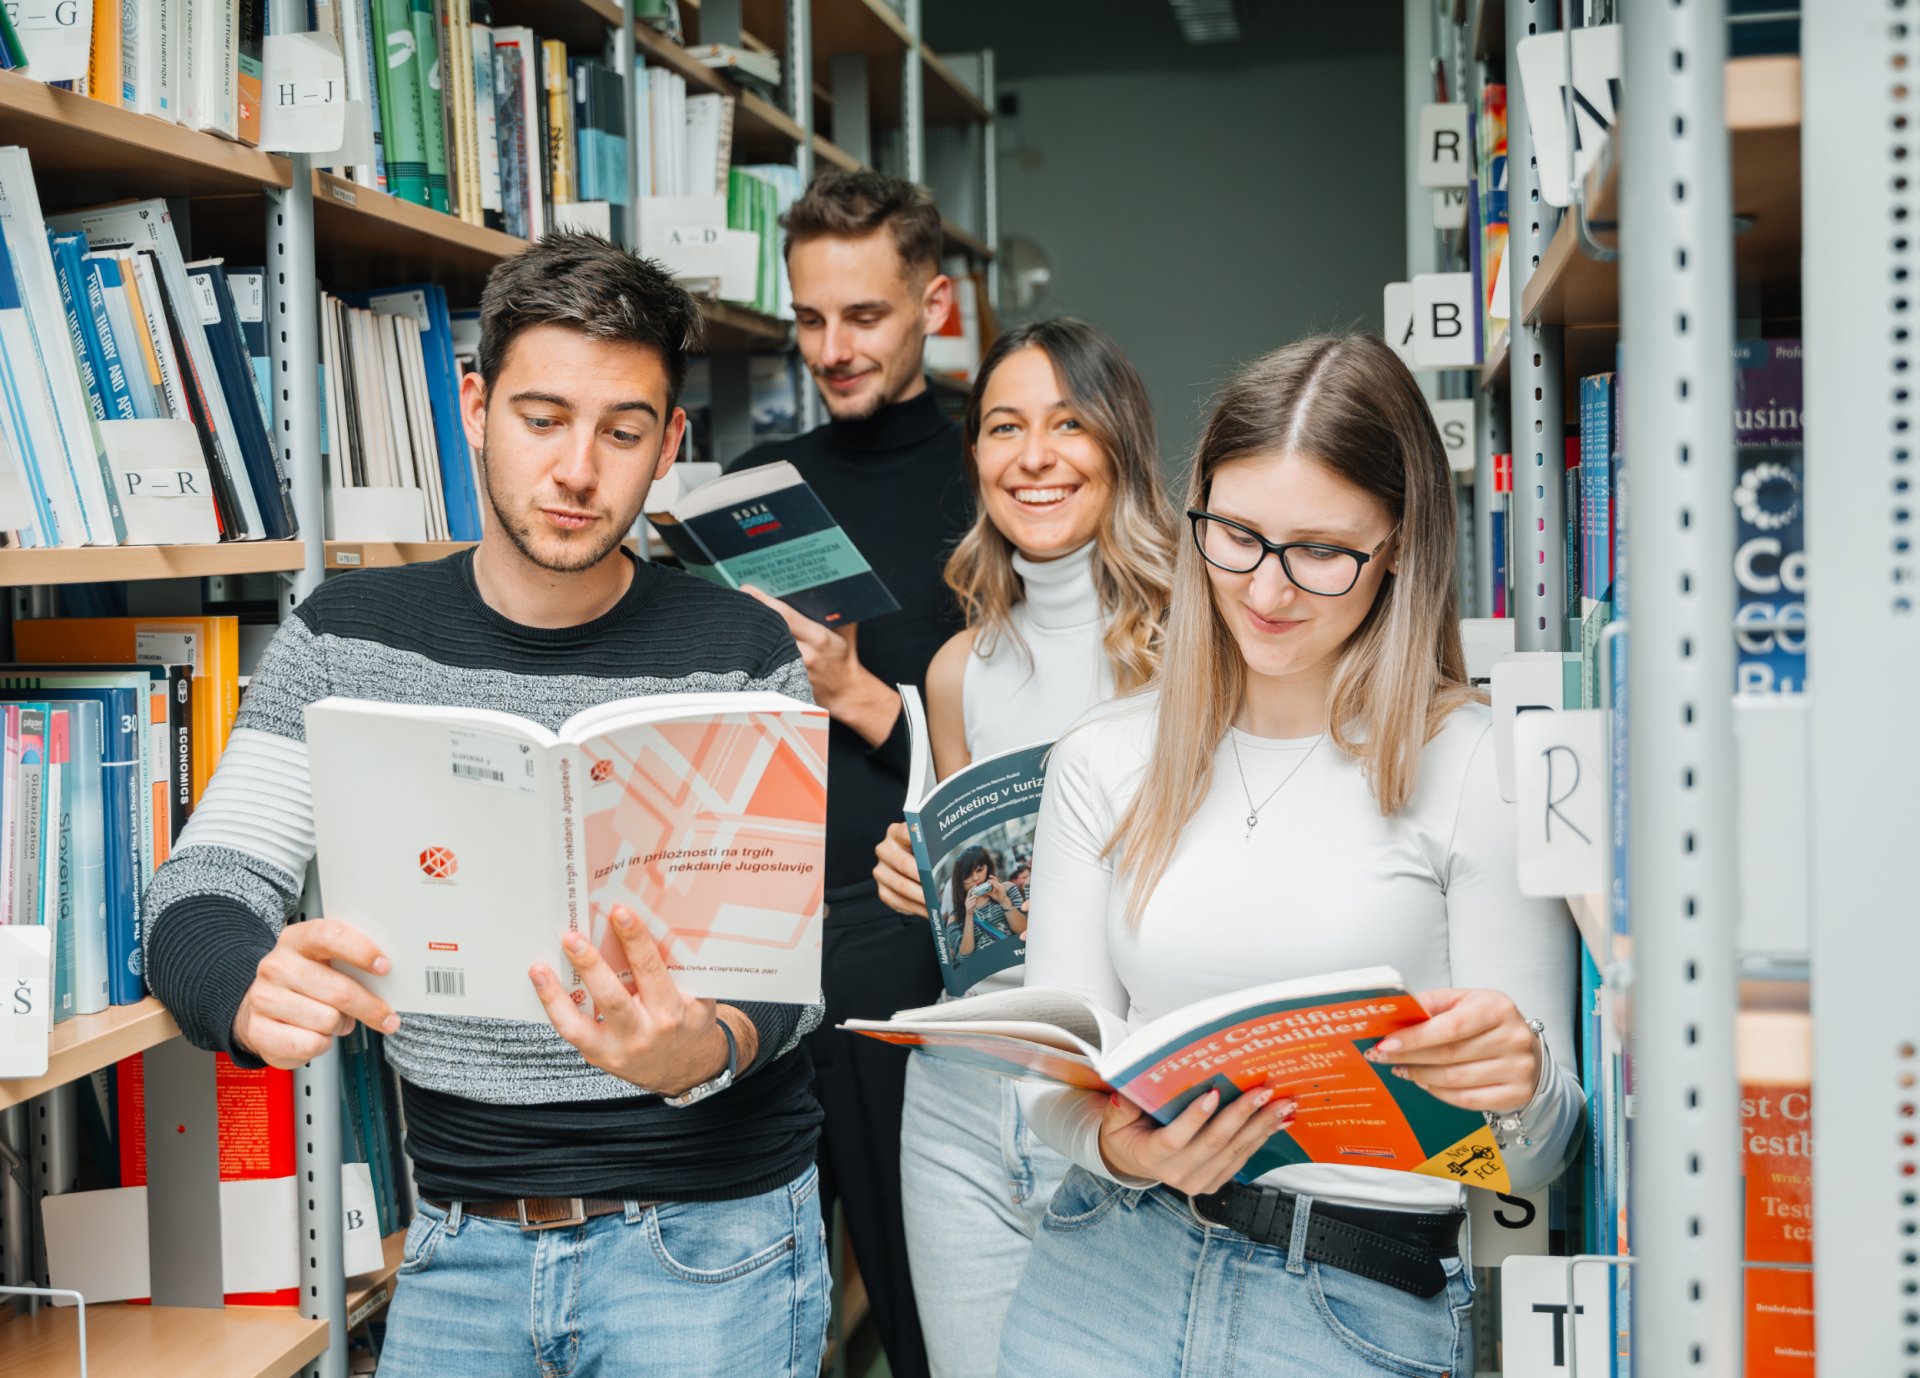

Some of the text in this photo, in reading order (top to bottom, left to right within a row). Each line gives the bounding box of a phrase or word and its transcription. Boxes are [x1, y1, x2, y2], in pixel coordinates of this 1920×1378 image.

[55, 0, 78, 26] G
[160, 33, 168, 88] TOURISTIQUE
[278, 83, 296, 106] H
[324, 80, 334, 104] J
[1432, 130, 1460, 163] R
[668, 230, 682, 246] A
[703, 228, 717, 244] D
[58, 267, 73, 306] PRICE
[67, 307, 87, 356] THEORY
[81, 361, 96, 391] AND
[86, 271, 103, 312] PRICE
[95, 313, 117, 361] THEORY
[108, 364, 126, 393] AND
[1431, 302, 1462, 338] B
[1442, 419, 1465, 451] S
[124, 472, 142, 495] P
[175, 471, 200, 494] R
[1600, 401, 1608, 536] BUSINESS MATTERS
[121, 713, 138, 734] 30
[179, 727, 189, 805] ECONOMICS
[129, 776, 137, 811] Decade
[560, 758, 574, 815] Jugoslavije
[1540, 745, 1592, 844] R
[30, 773, 39, 860] Globalization
[130, 813, 138, 833] Last
[938, 791, 999, 832] Marketing
[1001, 787, 1010, 797] v
[563, 817, 576, 860] nekdanje
[132, 852, 139, 862] of
[593, 861, 626, 880] Izzivi
[628, 855, 641, 866] in
[643, 847, 718, 865] priložnosti
[742, 847, 774, 859] trgih
[669, 860, 814, 874] nekdanje Jugoslavije
[566, 863, 579, 887] trgih
[132, 863, 140, 921] Significance
[568, 888, 578, 900] na
[938, 935, 950, 965] Marketing
[709, 966, 760, 974] KONFERENCA
[13, 979, 32, 1015] Š
[1146, 1002, 1399, 1084] First Certificate
[1190, 1019, 1369, 1073] Testbuilder
[1240, 1050, 1348, 1077] Tests that
[1266, 1059, 1334, 1078] teach!
[1303, 1119, 1334, 1128] Tony
[1445, 1144, 1470, 1160] New
[1473, 1160, 1501, 1180] FCE
[346, 1208, 365, 1231] B
[1531, 1303, 1585, 1367] T
[1774, 1346, 1808, 1358] Guidance
